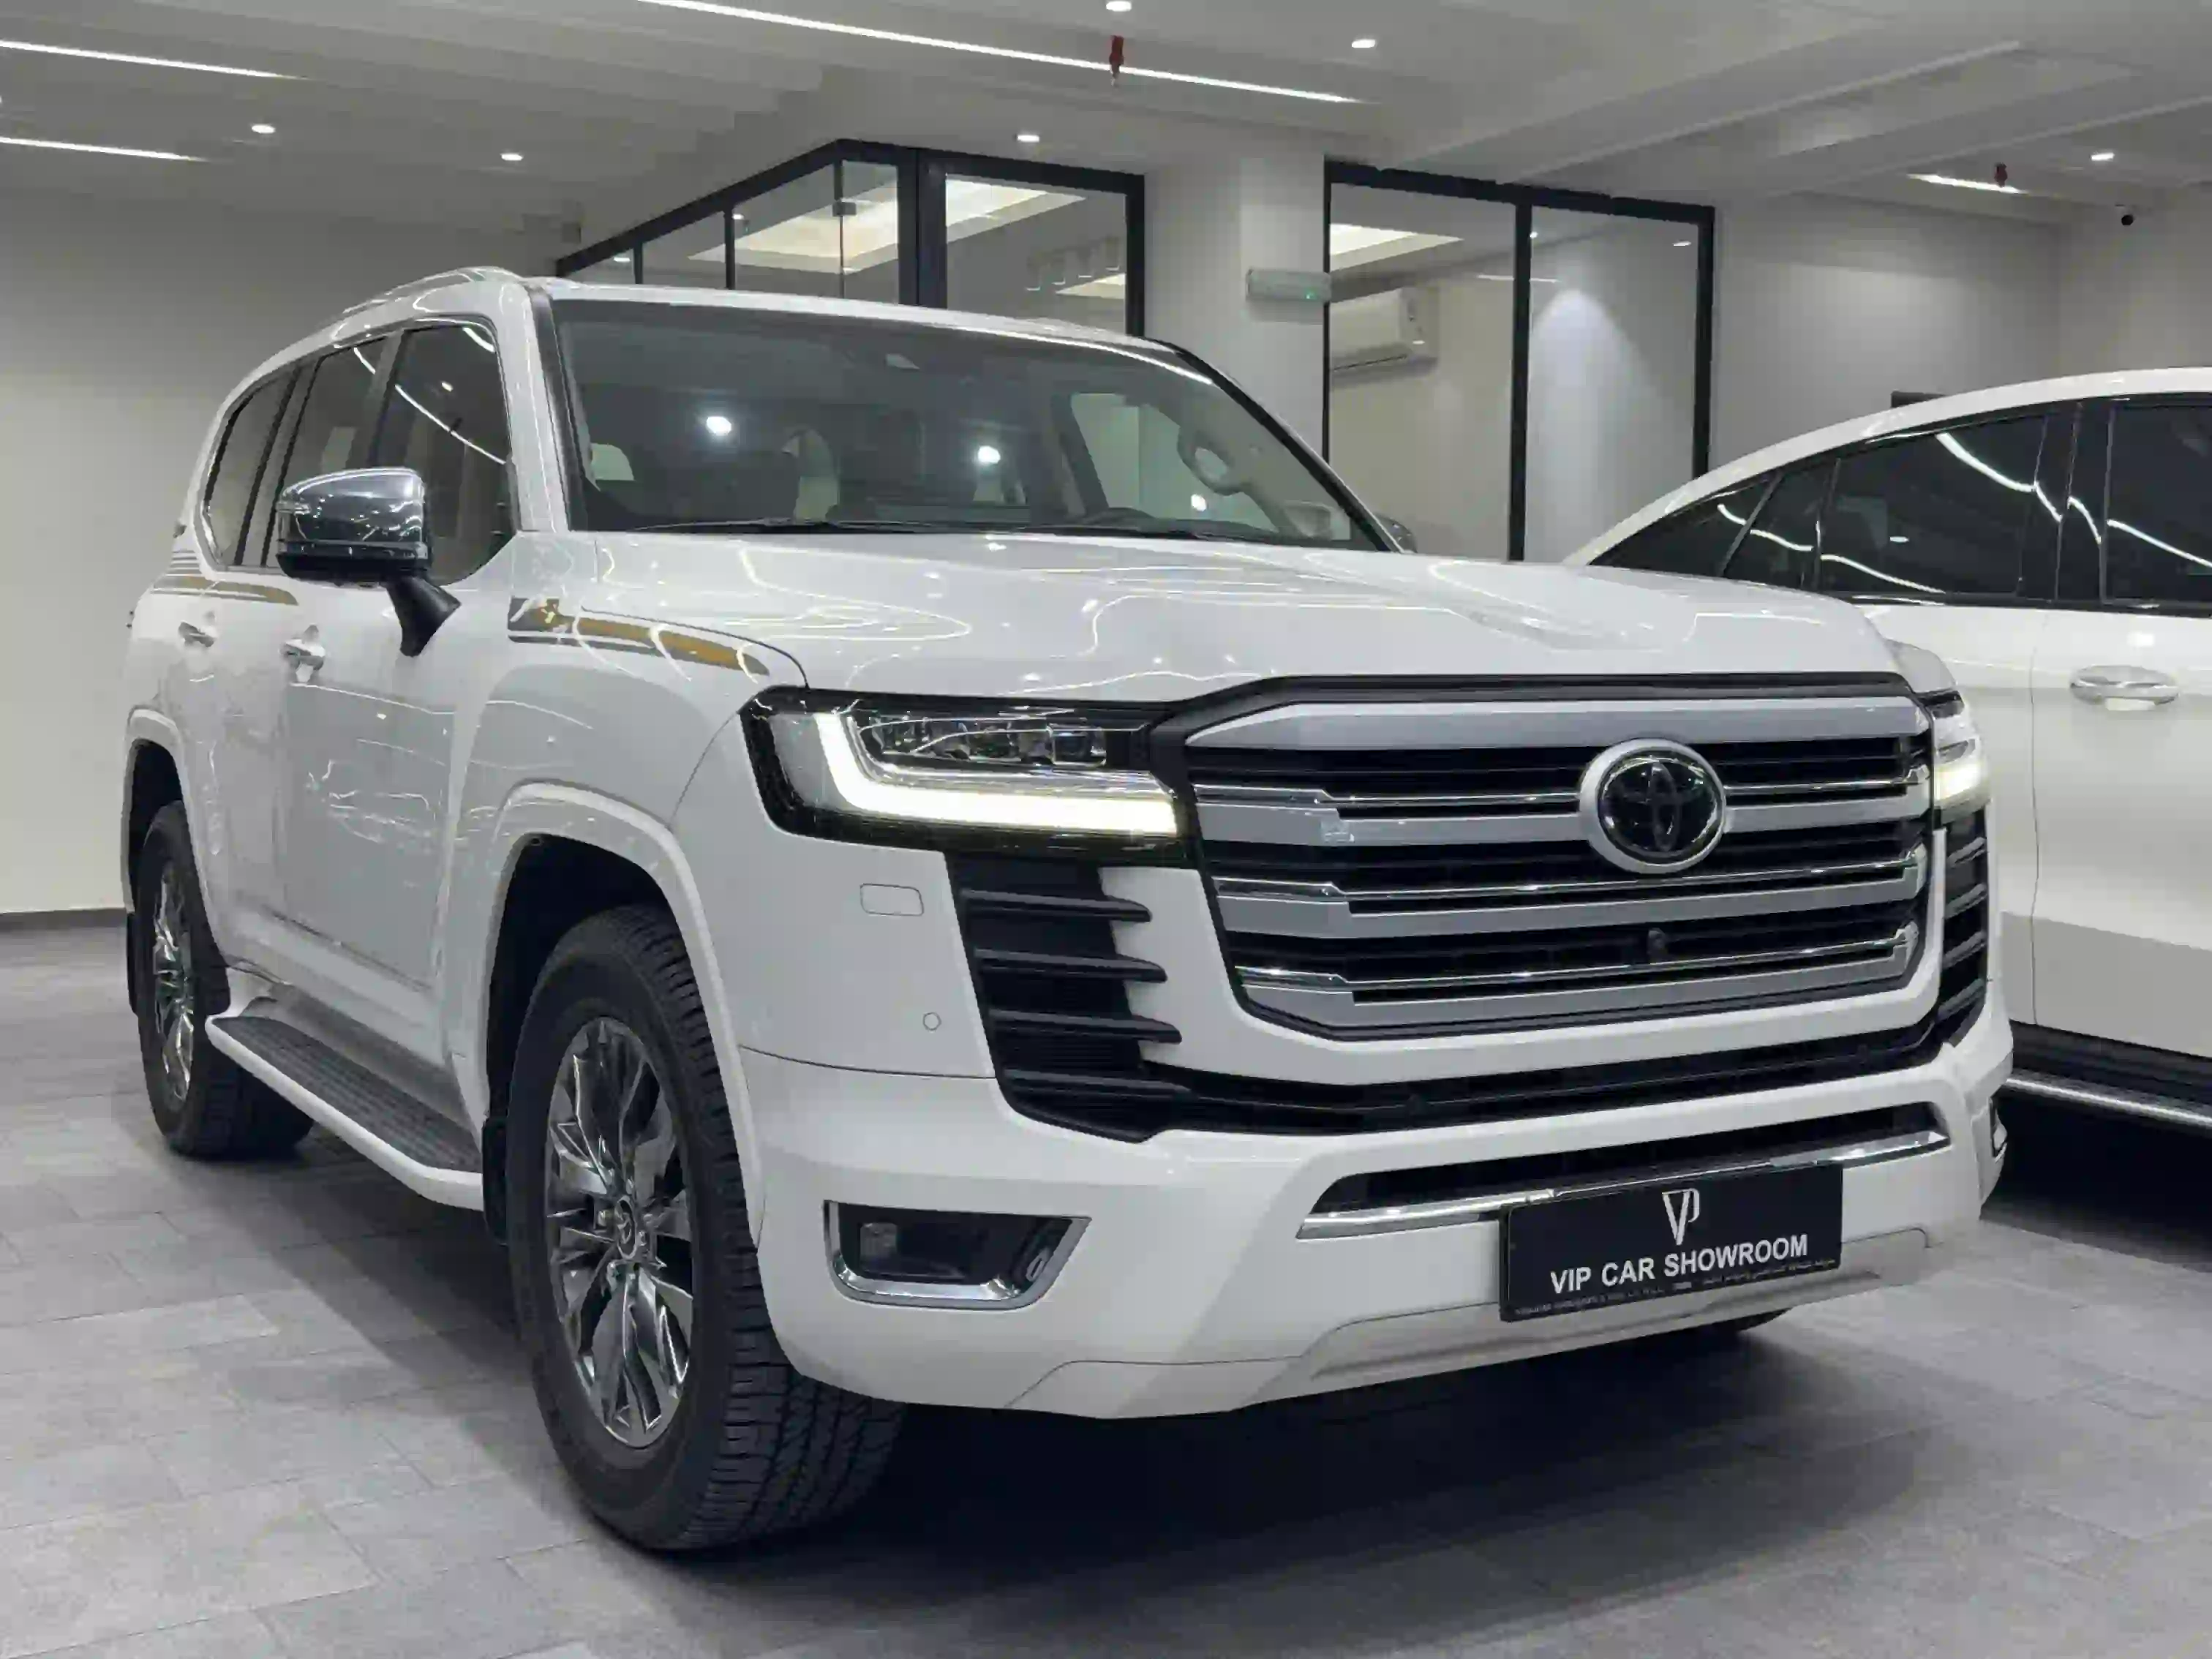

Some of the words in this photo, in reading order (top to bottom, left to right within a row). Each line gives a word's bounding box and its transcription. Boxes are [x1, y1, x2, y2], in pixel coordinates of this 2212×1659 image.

[1550, 1266, 1592, 1294] VIP
[1601, 1257, 1655, 1287] CAR
[1663, 1233, 1807, 1277] SHOWROOM
